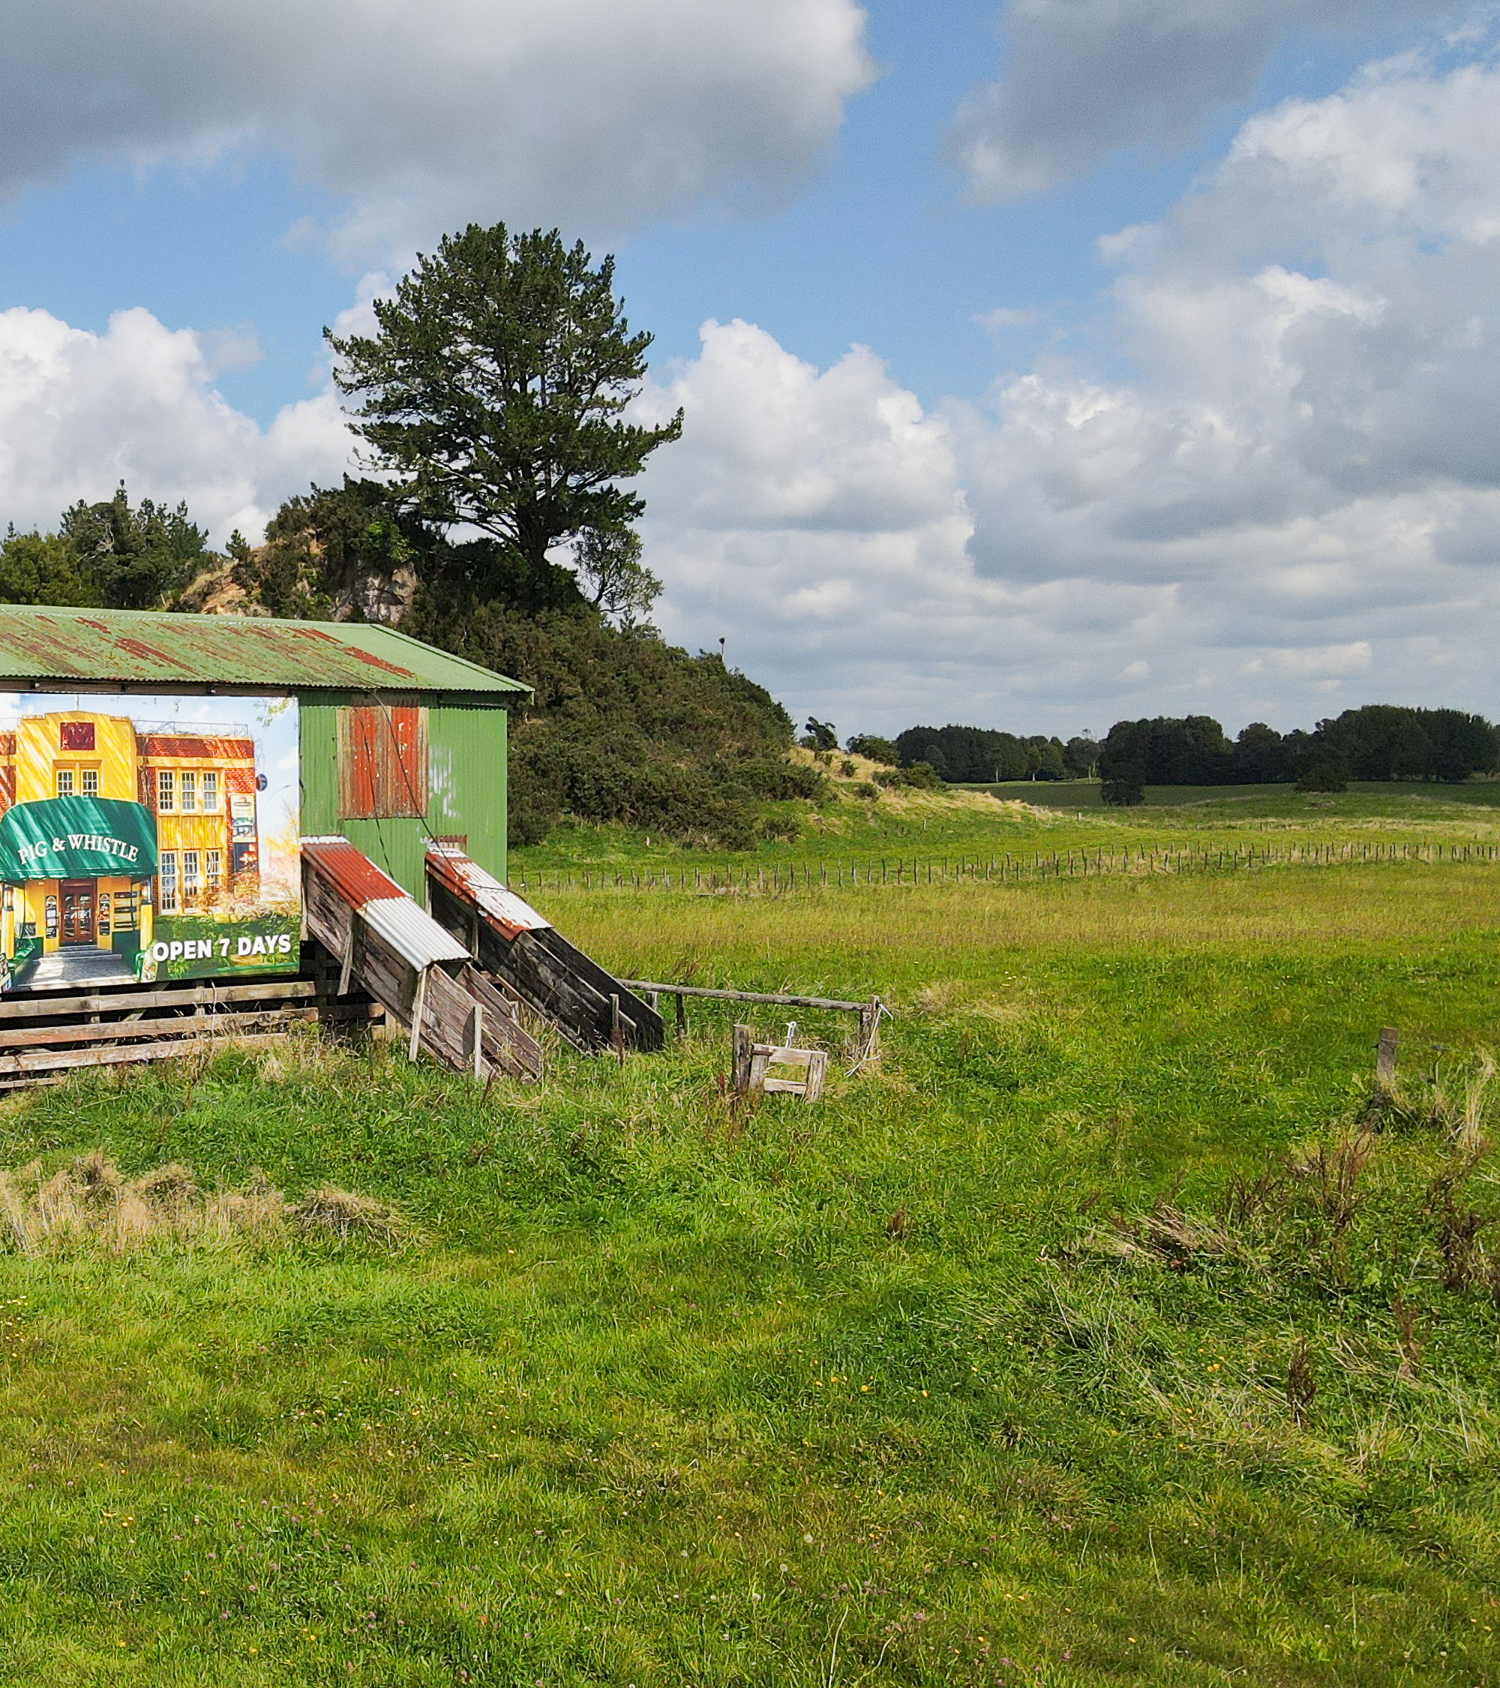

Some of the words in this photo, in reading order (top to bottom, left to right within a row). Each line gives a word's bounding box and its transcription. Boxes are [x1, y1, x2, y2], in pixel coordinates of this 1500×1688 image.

[18, 841, 48, 865] PIG
[52, 837, 66, 853] &
[67, 833, 139, 862] WHISTLE
[152, 939, 212, 962] OPEN
[219, 938, 231, 957] 7
[238, 934, 292, 956] DAYS
